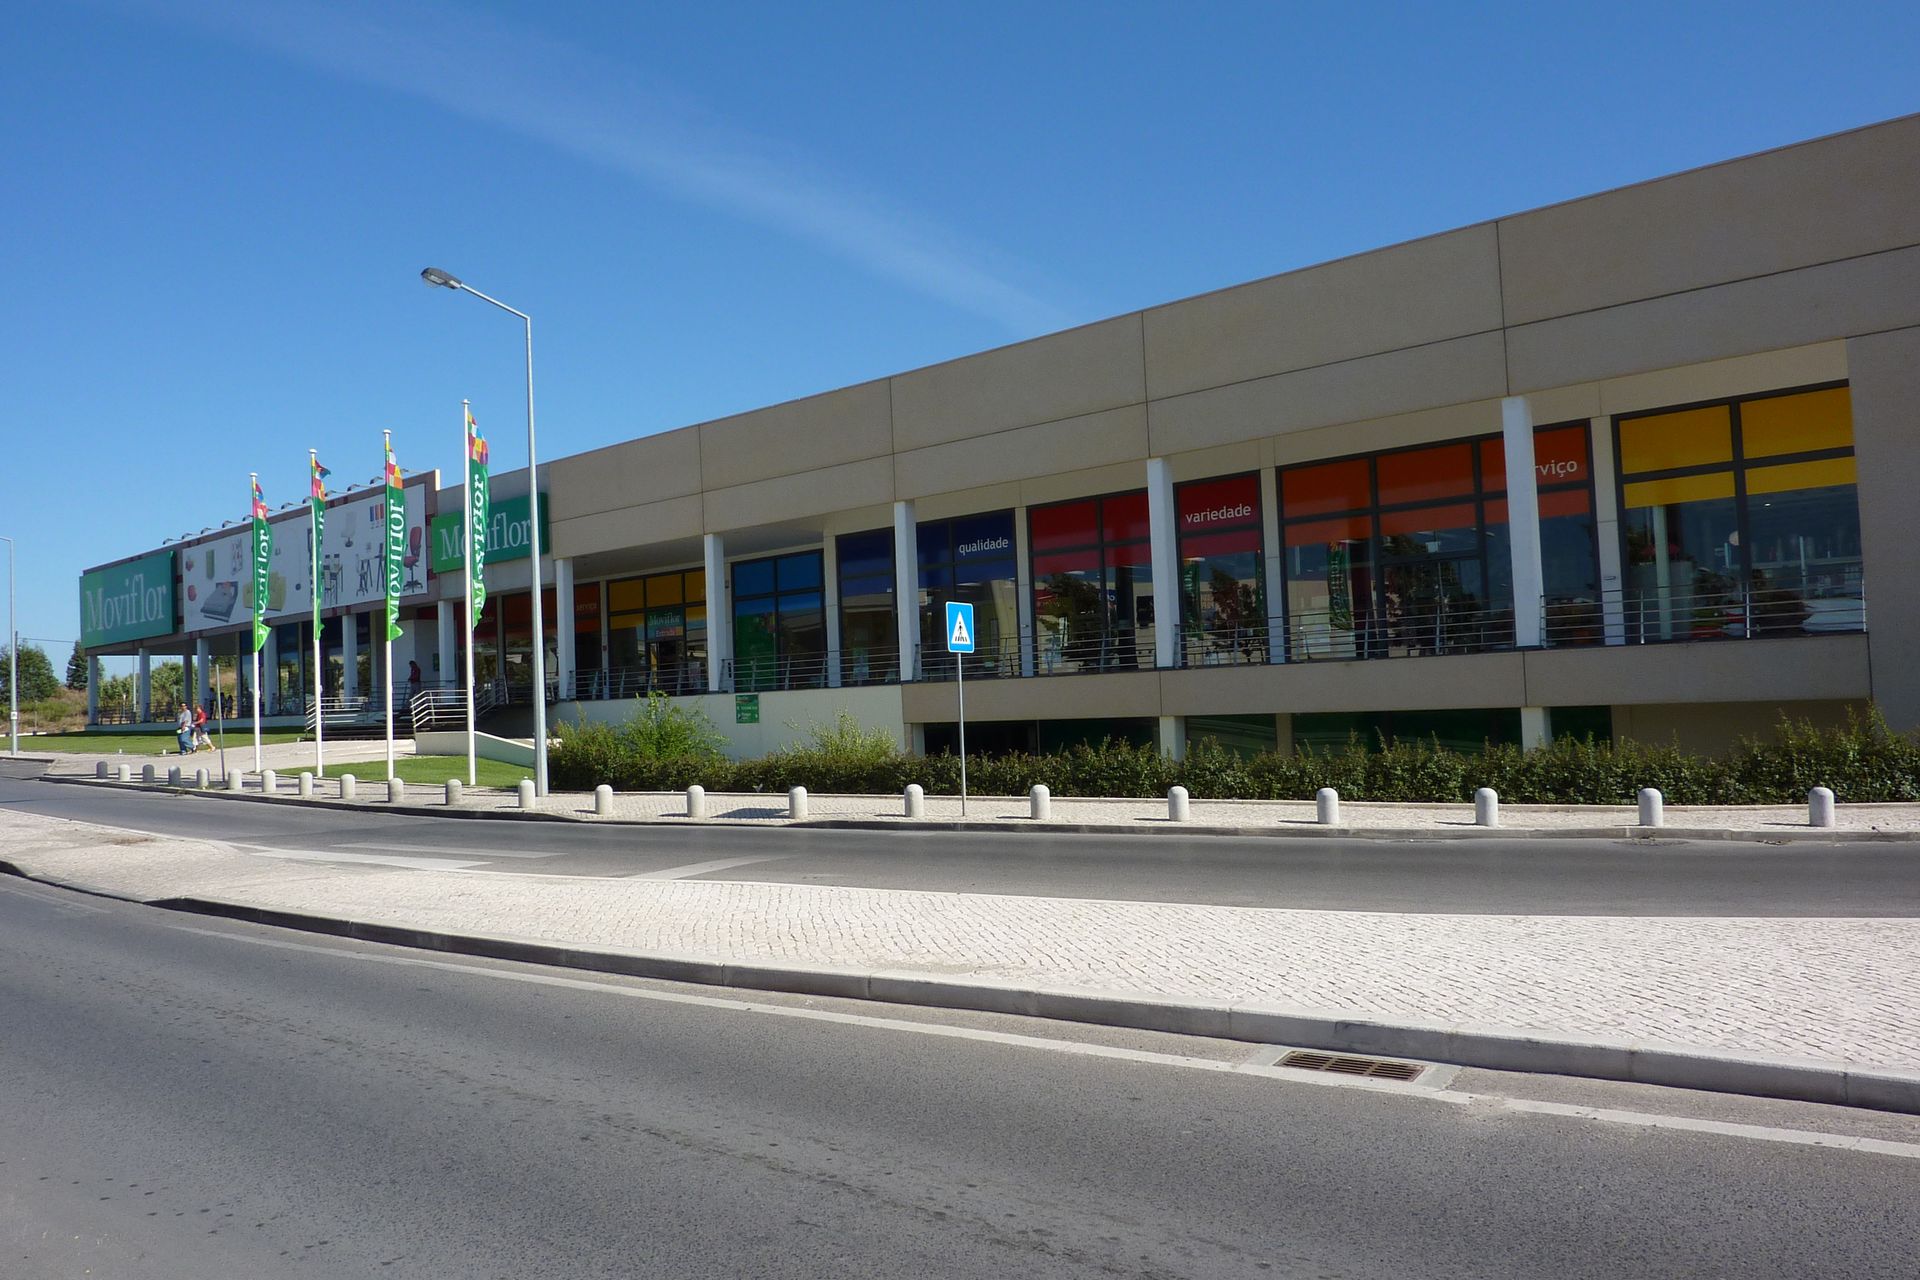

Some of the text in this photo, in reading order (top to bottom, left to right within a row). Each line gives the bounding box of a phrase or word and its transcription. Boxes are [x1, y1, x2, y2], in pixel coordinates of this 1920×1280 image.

[1185, 503, 1252, 523] variedade
[440, 512, 531, 561] Miflor
[958, 537, 1009, 556] qualidade
[86, 573, 167, 633] Moviflor
